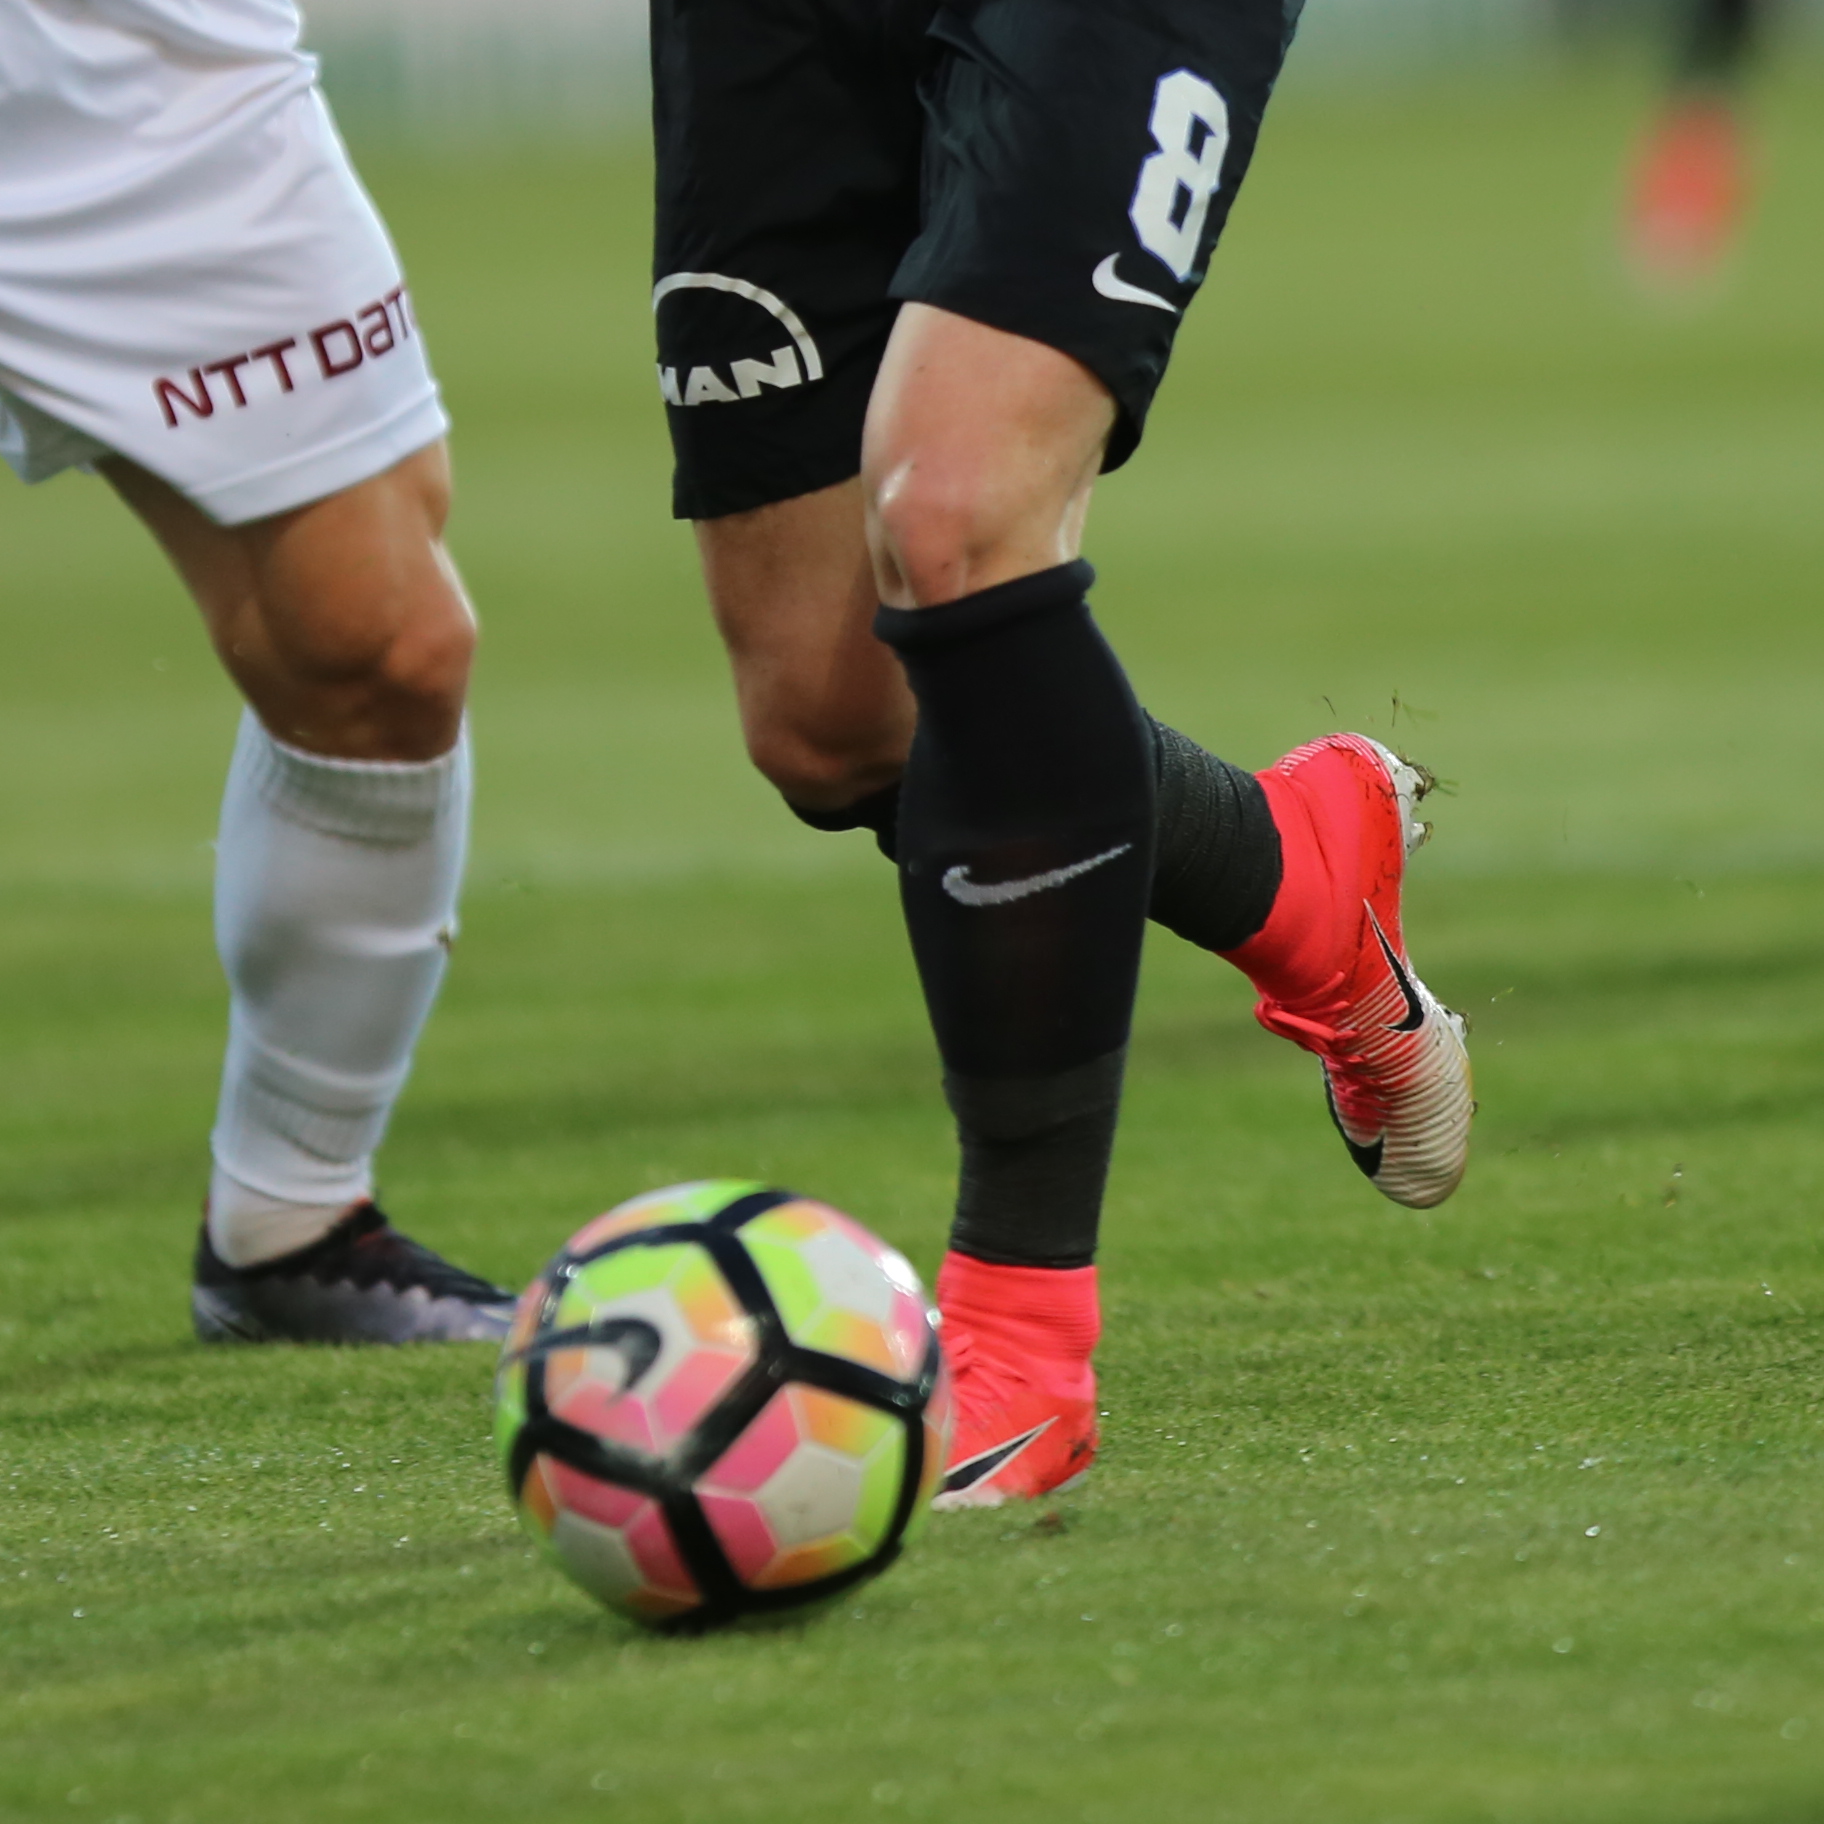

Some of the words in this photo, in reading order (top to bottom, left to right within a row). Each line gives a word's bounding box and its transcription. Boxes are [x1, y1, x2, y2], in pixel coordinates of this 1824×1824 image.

[1129, 67, 1230, 283] 8
[151, 336, 297, 430] NTT
[307, 283, 409, 380] DaT
[655, 345, 803, 407] MAN
